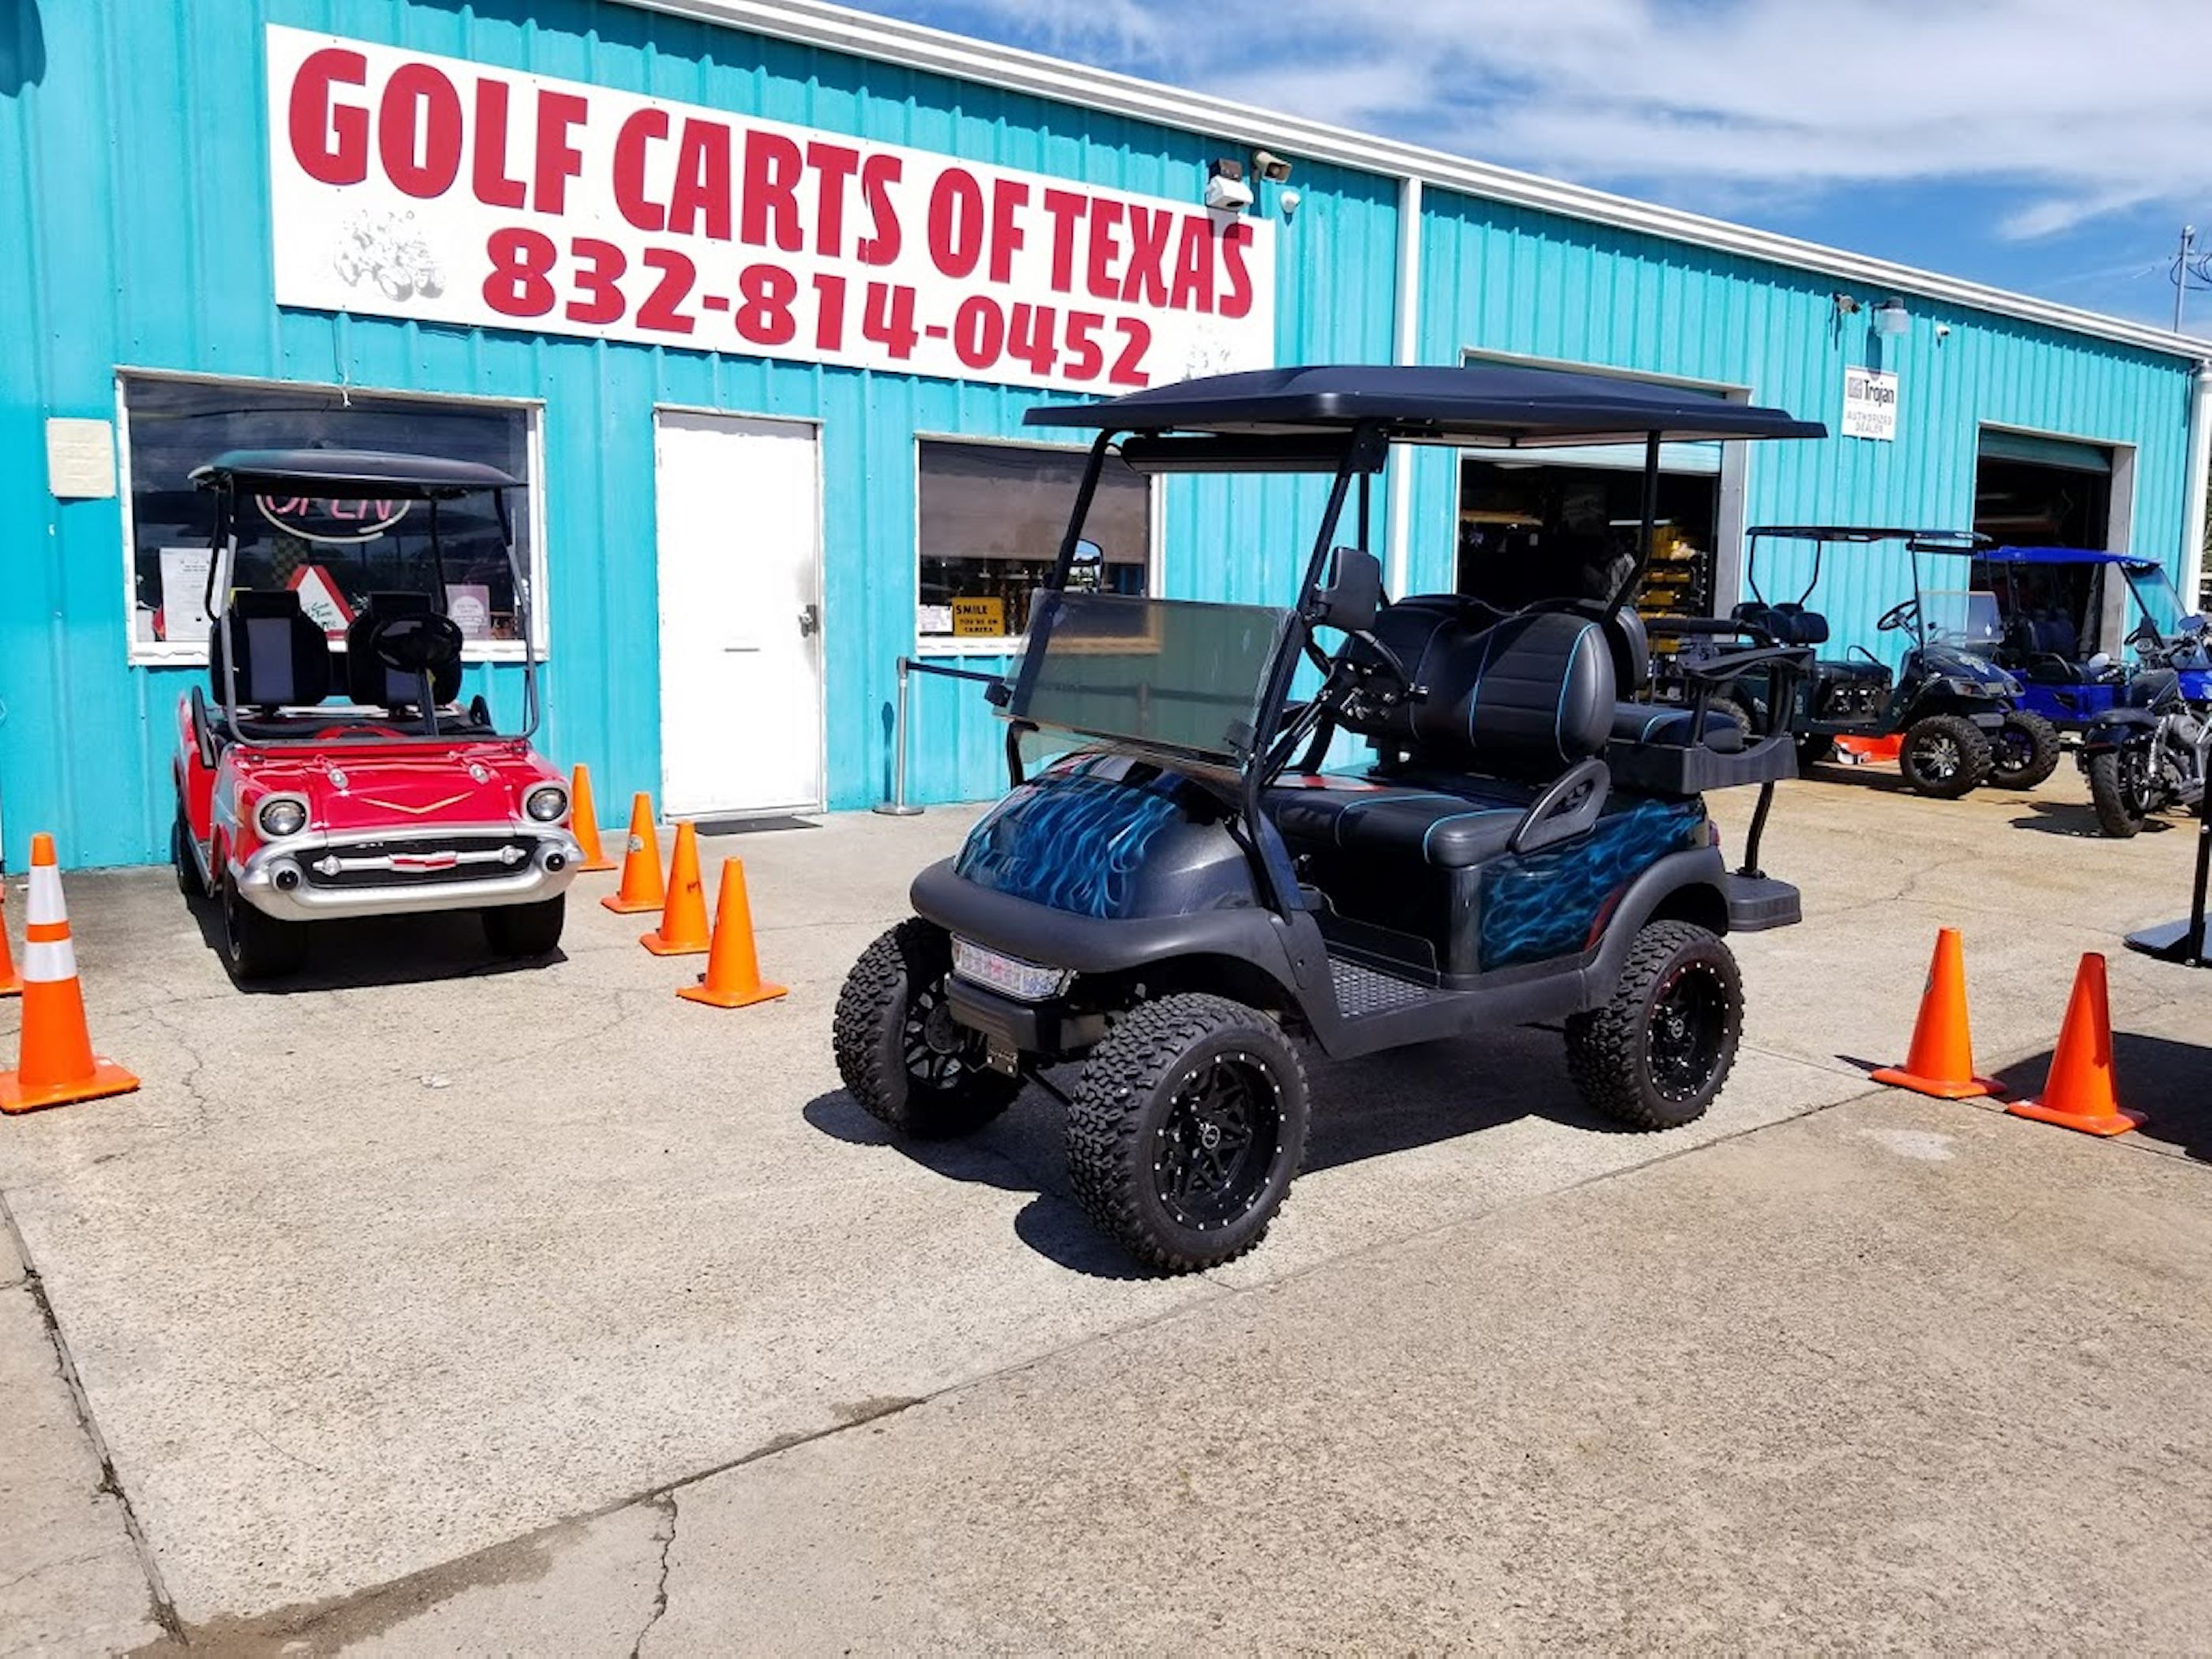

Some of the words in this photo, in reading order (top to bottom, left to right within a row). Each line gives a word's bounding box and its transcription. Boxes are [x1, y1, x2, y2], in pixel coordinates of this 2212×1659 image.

[289, 48, 587, 214] GOLF
[613, 109, 901, 265] CARTS
[928, 168, 1029, 282] OF
[1044, 189, 1253, 318] TEXAS
[483, 228, 1151, 386] 832-814-0452
[1864, 379, 1894, 407] Trojan
[1846, 410, 1892, 426] AUTHORIZED
[1855, 420, 1883, 434] DEALER
[956, 604, 988, 615] SMILE
